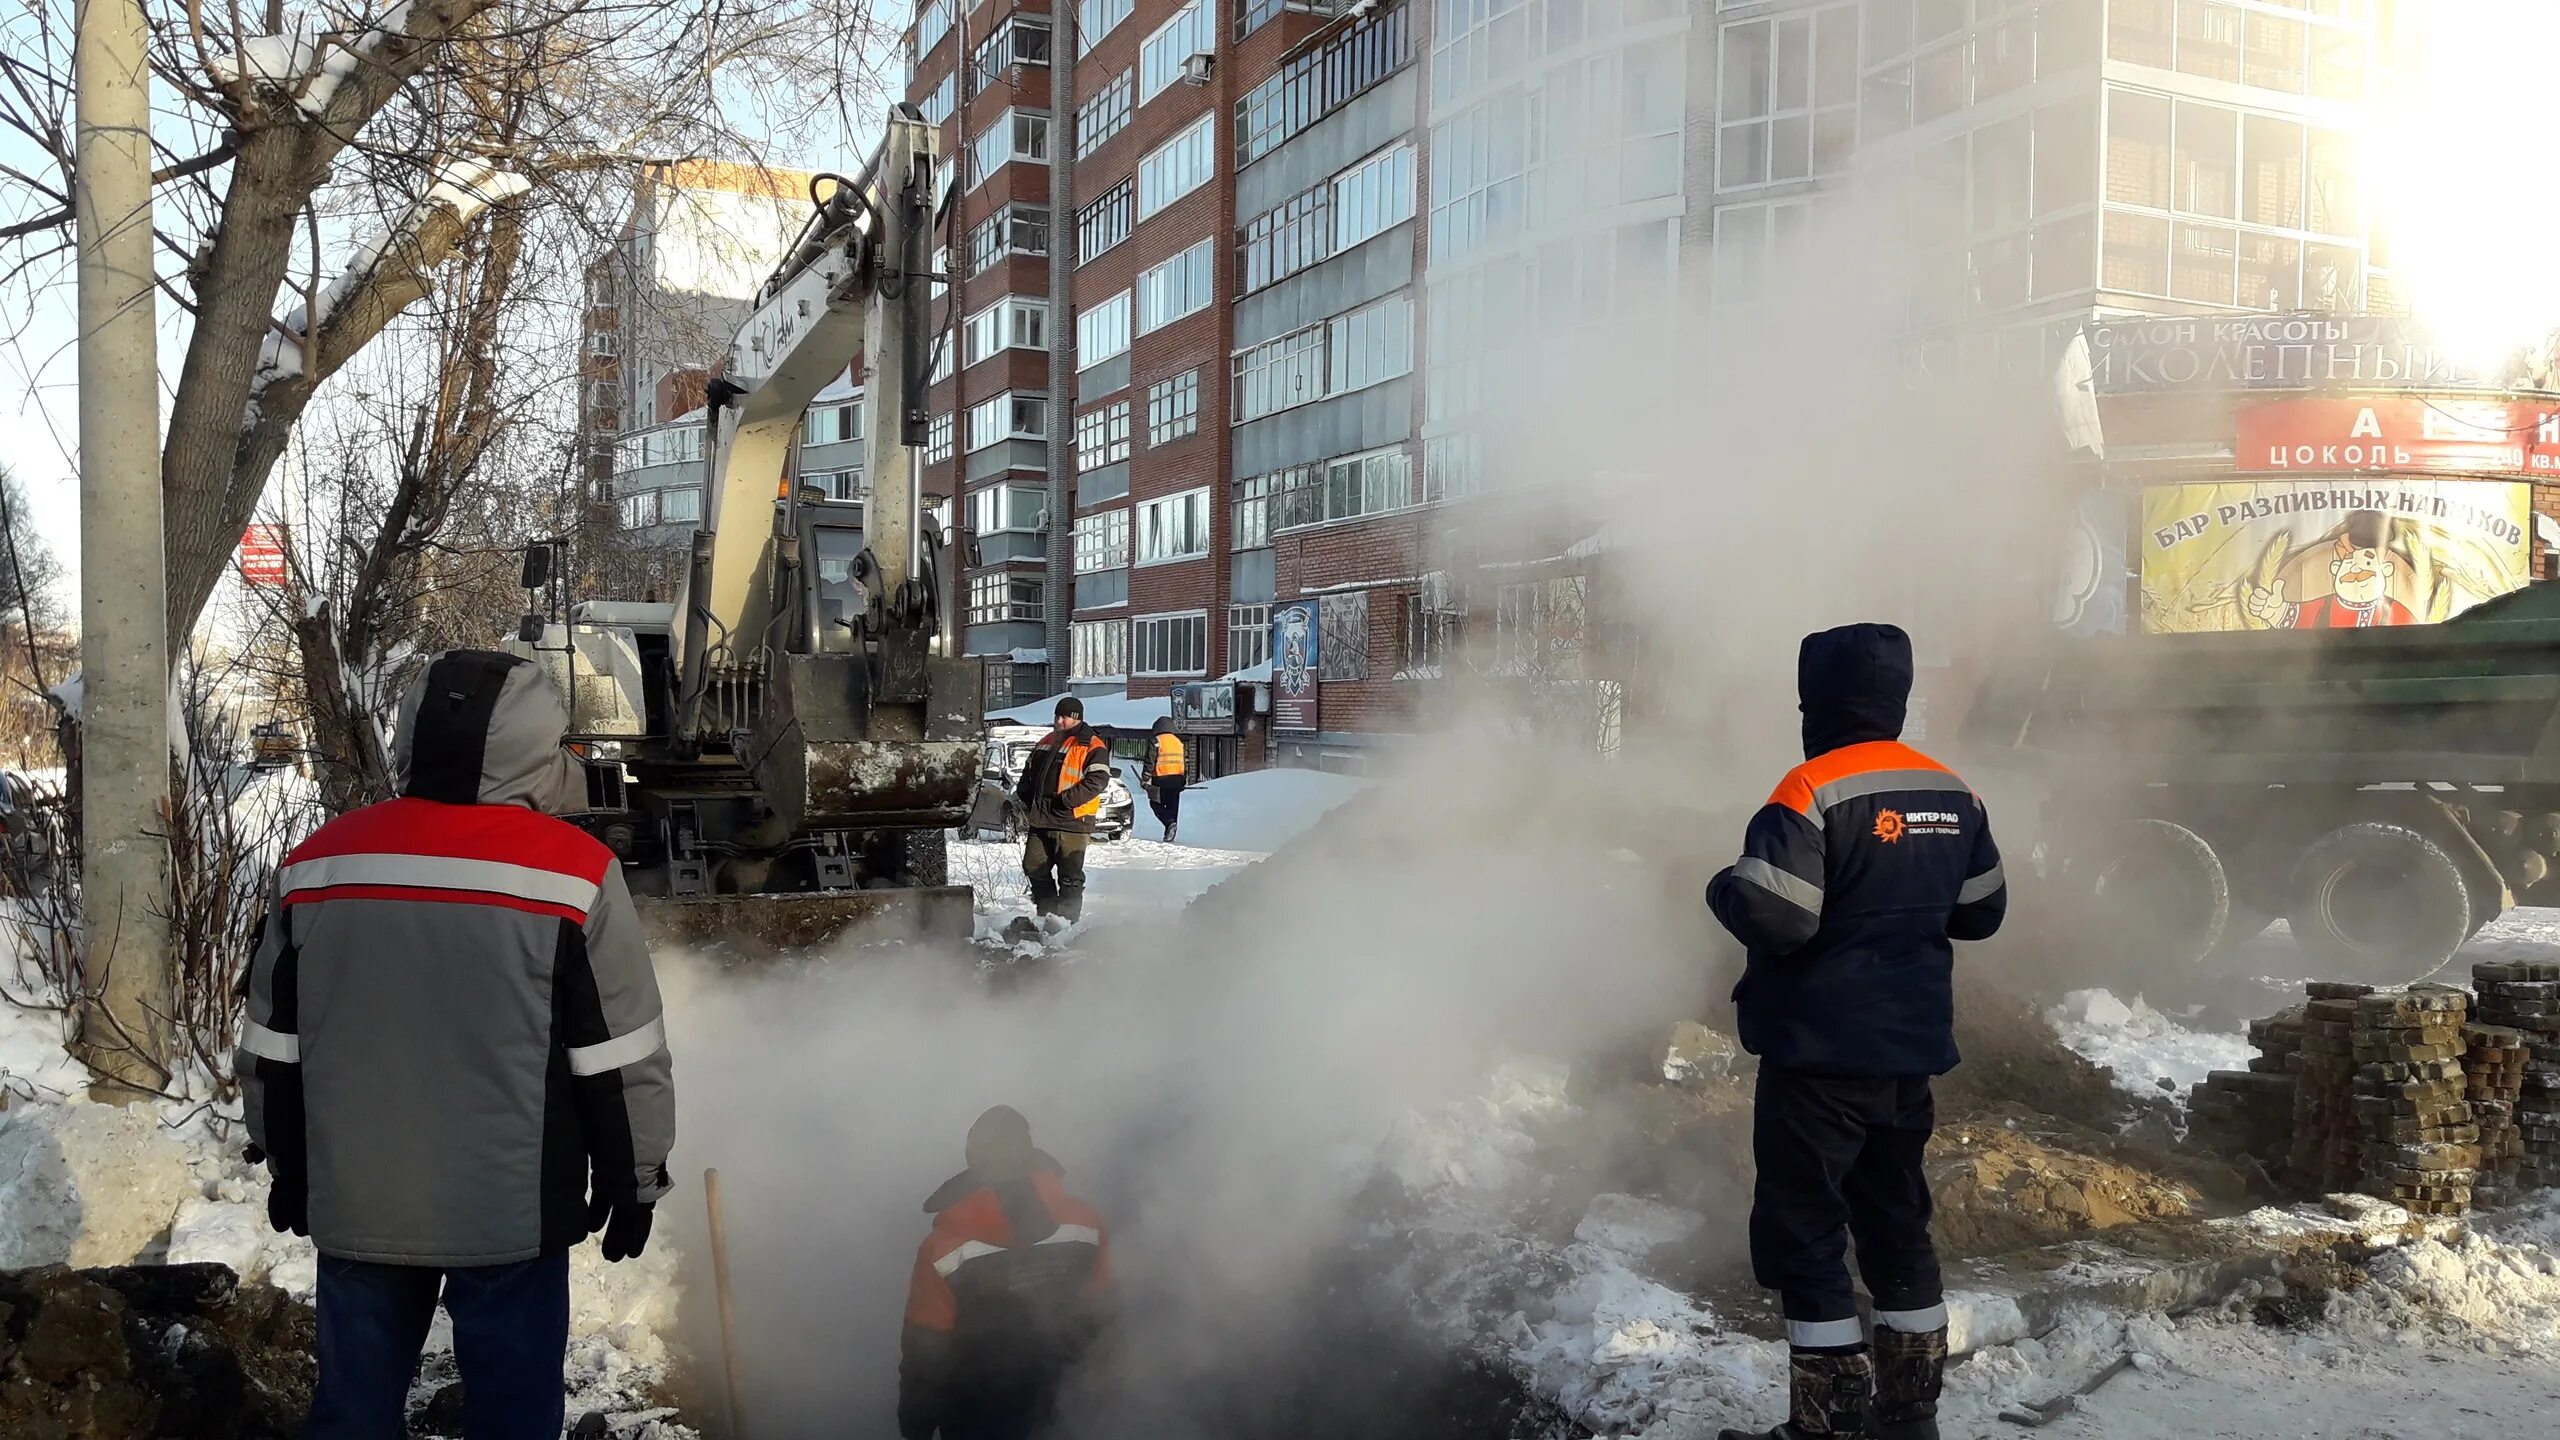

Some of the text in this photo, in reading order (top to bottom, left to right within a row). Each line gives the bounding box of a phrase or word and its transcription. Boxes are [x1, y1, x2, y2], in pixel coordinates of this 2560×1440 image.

[2093, 321, 2349, 348] САЛОН КРАСОТЫ
[2269, 444, 2412, 468] ЦОКОЛЬ
[2153, 489, 2522, 549] БАР РАЗЛИВНЫХ НАПКОВ
[1906, 812, 1959, 823] ИНТЕР РАО
